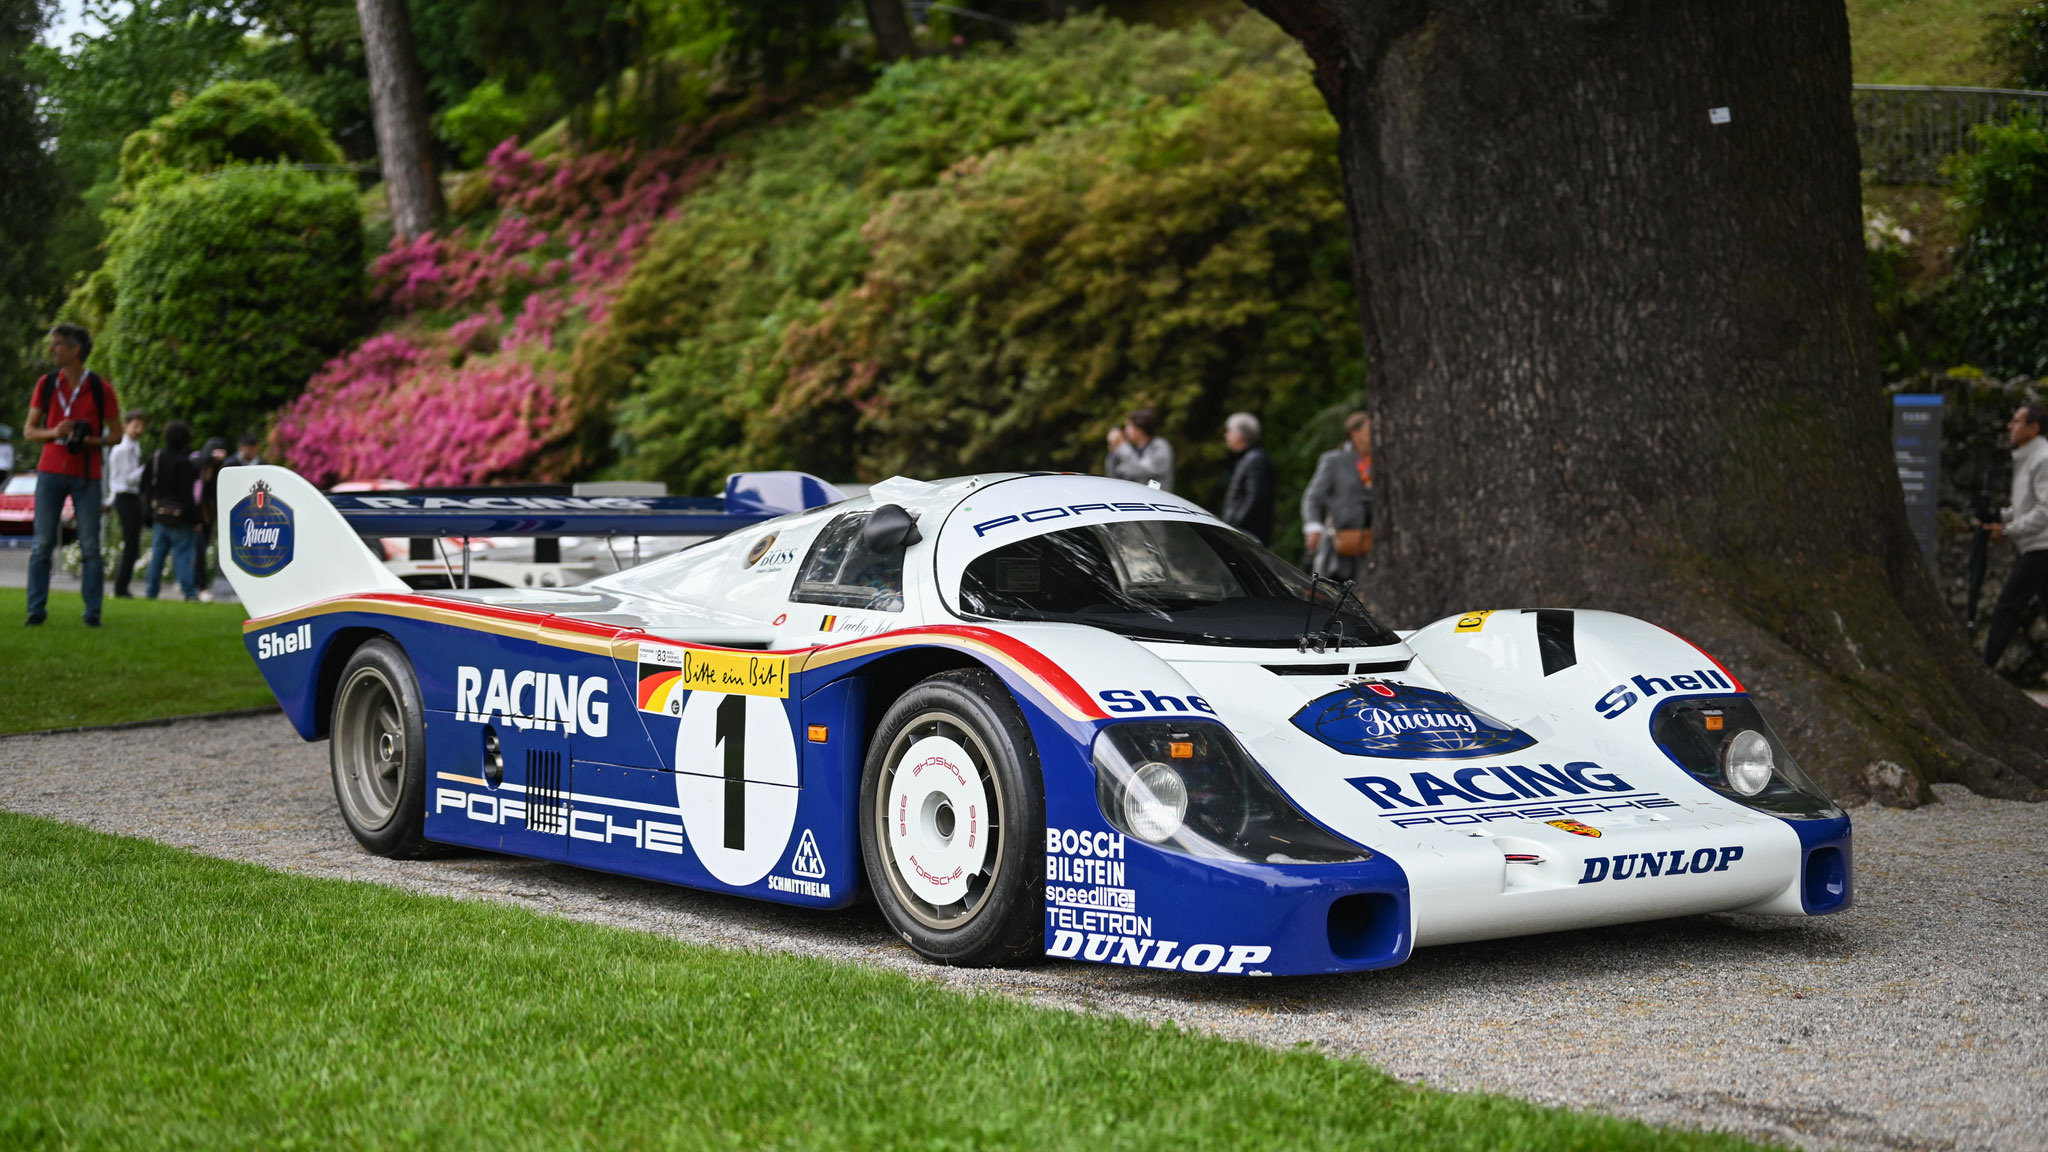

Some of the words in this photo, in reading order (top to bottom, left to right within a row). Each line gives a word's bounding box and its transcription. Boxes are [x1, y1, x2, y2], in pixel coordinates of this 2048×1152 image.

[355, 497, 656, 510] RACING
[242, 518, 280, 551] Racing
[258, 624, 312, 660] Shell
[837, 616, 870, 640] Jacky
[684, 651, 717, 684] Bitte
[722, 668, 745, 686] ein
[749, 656, 786, 693] Bit!
[455, 665, 609, 738] RACING
[1594, 669, 1733, 720] Shell
[1358, 707, 1477, 736] Racing
[715, 694, 747, 851] 1
[913, 756, 966, 786] PORSCHE
[1344, 761, 1636, 810] RACING
[436, 787, 684, 855] PORSCHE
[1390, 797, 1681, 829] PORSCHE
[1046, 827, 1125, 859] BOSCH
[909, 855, 964, 886] PORSCHE
[1046, 855, 1125, 887] BILSTEIN
[1578, 845, 1744, 884] DUNLOP
[768, 874, 831, 899] SCHMITTHELM
[1045, 885, 1130, 908] speedline
[1046, 906, 1152, 937] TELETRON
[1045, 929, 1272, 974] DUNLOP
